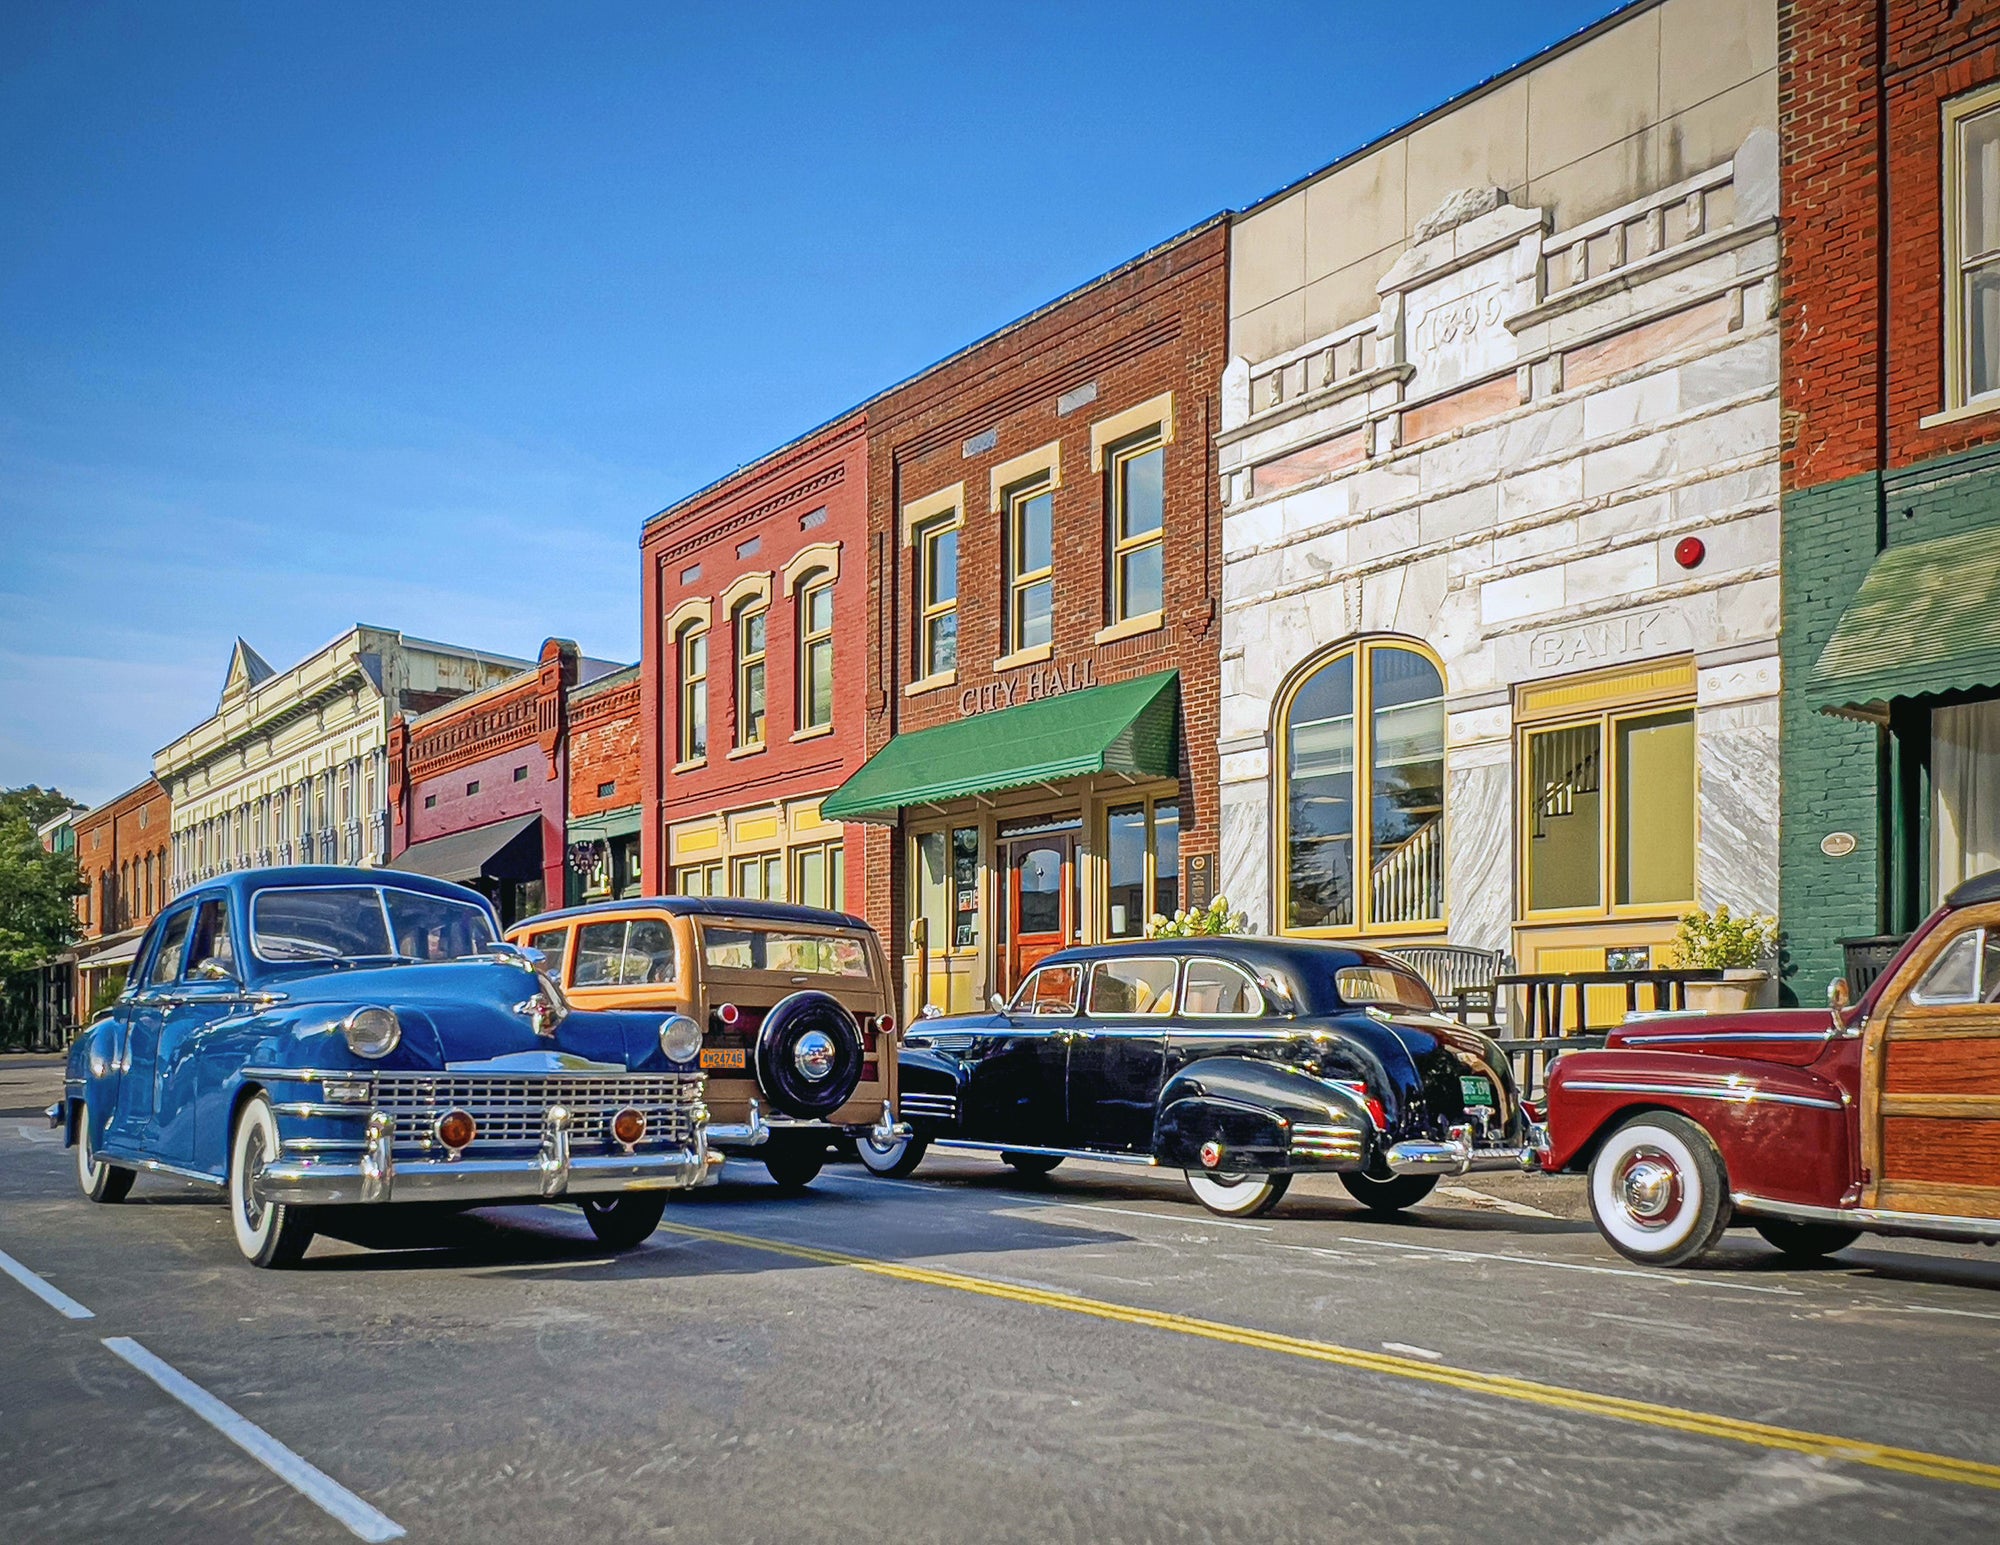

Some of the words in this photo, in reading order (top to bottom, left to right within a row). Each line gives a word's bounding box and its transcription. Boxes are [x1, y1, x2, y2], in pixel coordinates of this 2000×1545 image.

[1535, 610, 1668, 669] BANK
[959, 677, 1018, 717] CITY
[1027, 657, 1098, 702] HALL
